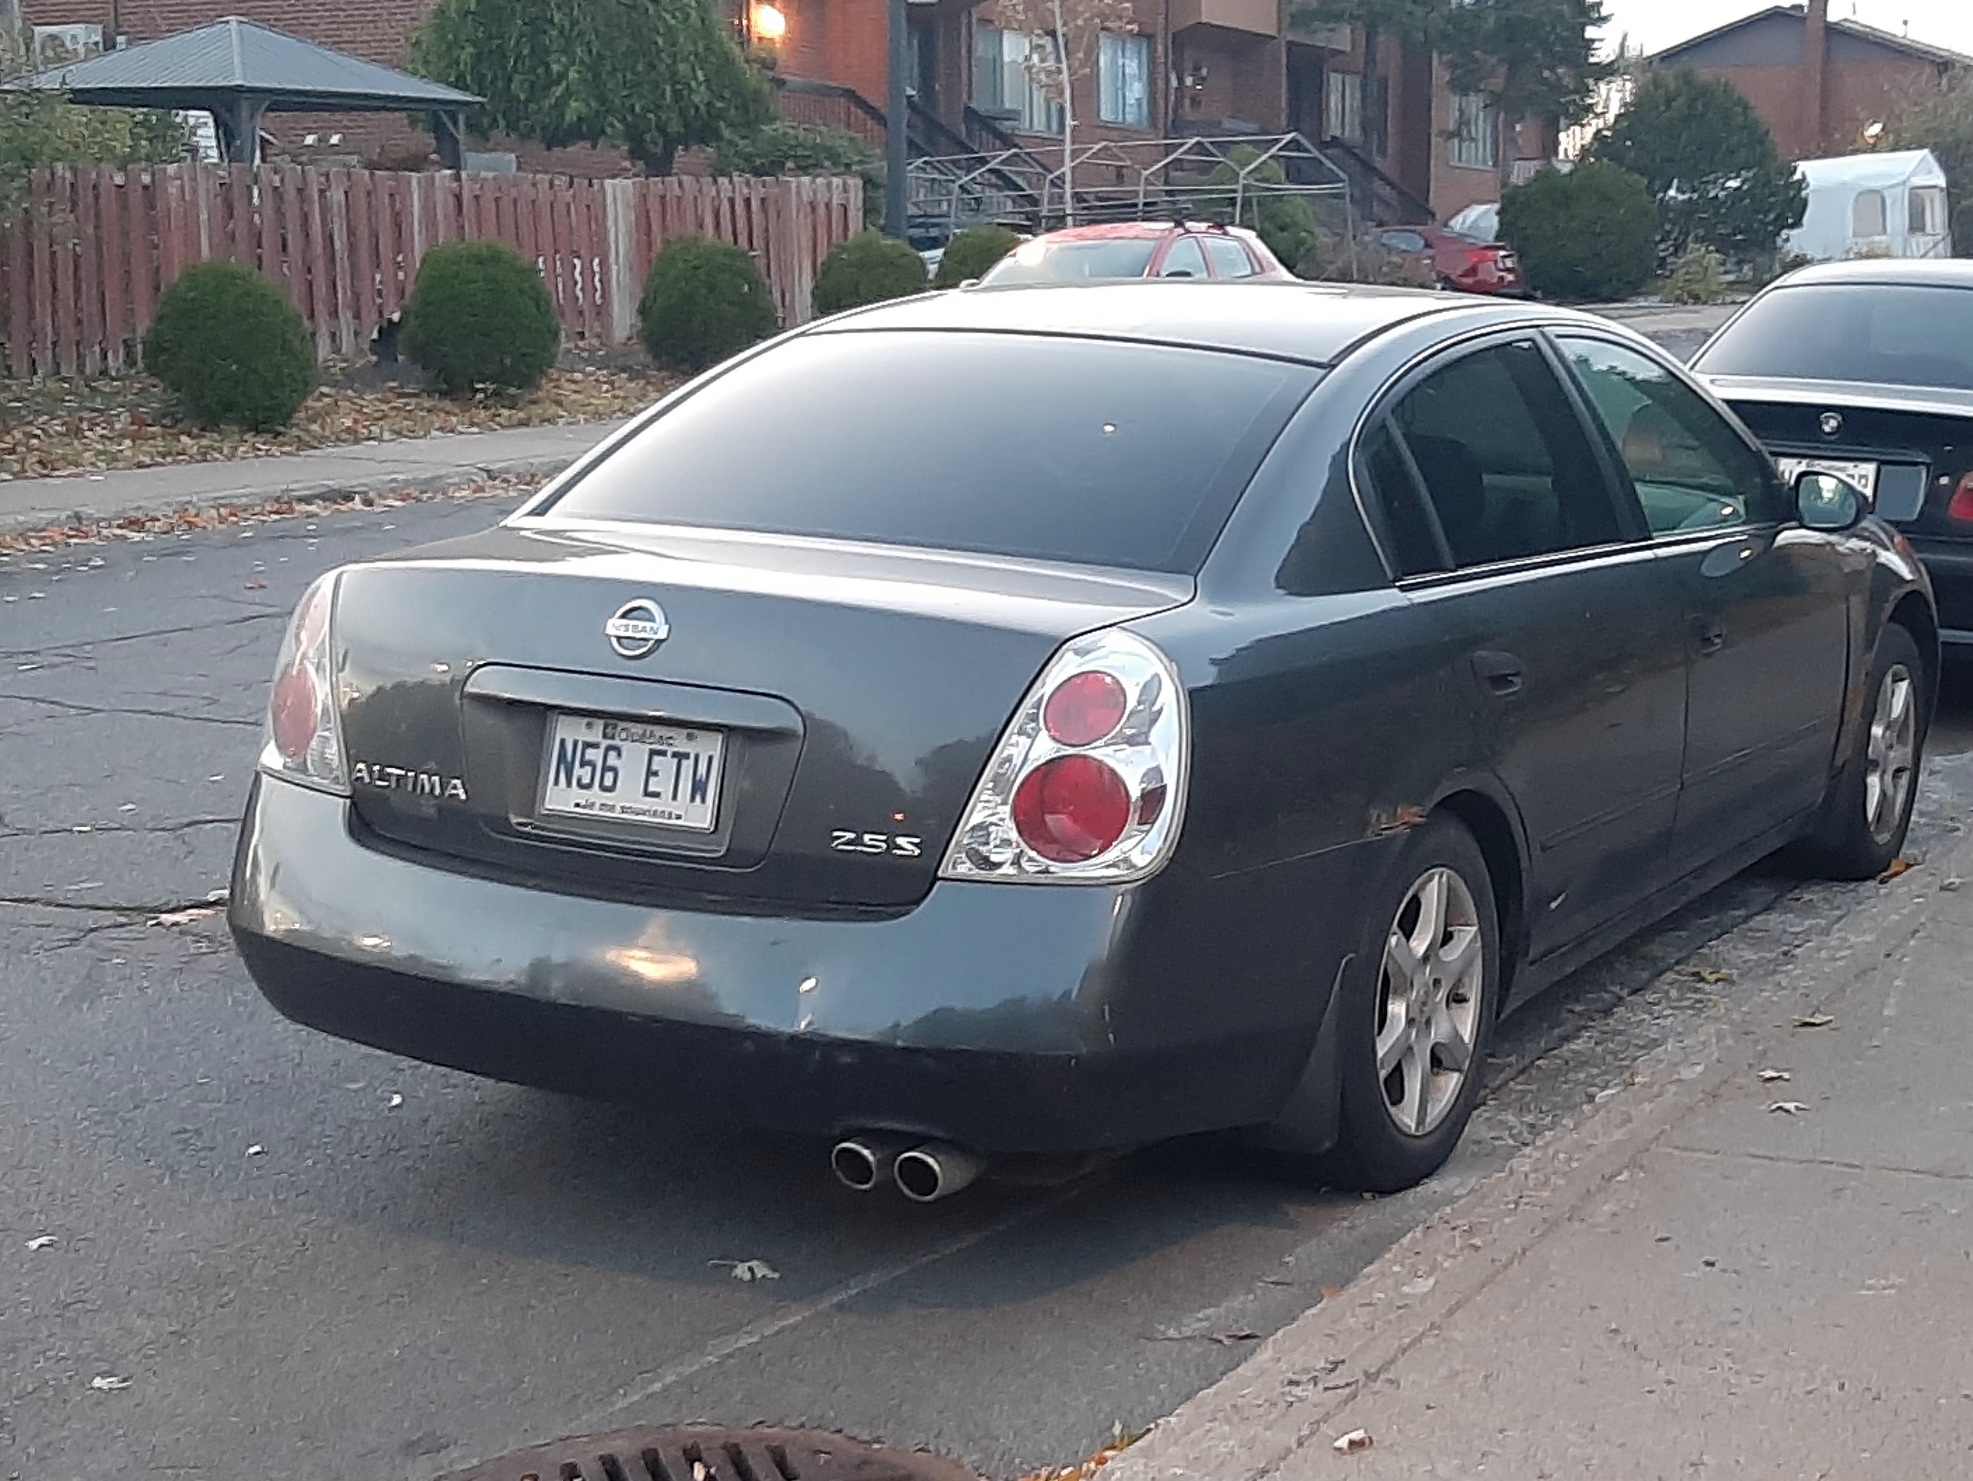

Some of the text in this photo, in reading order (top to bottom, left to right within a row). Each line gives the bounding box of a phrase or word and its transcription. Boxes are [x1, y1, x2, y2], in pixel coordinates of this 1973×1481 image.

[351, 761, 468, 800] ALTIMA
[553, 738, 714, 804] N56 ETW
[891, 836, 922, 856] S
